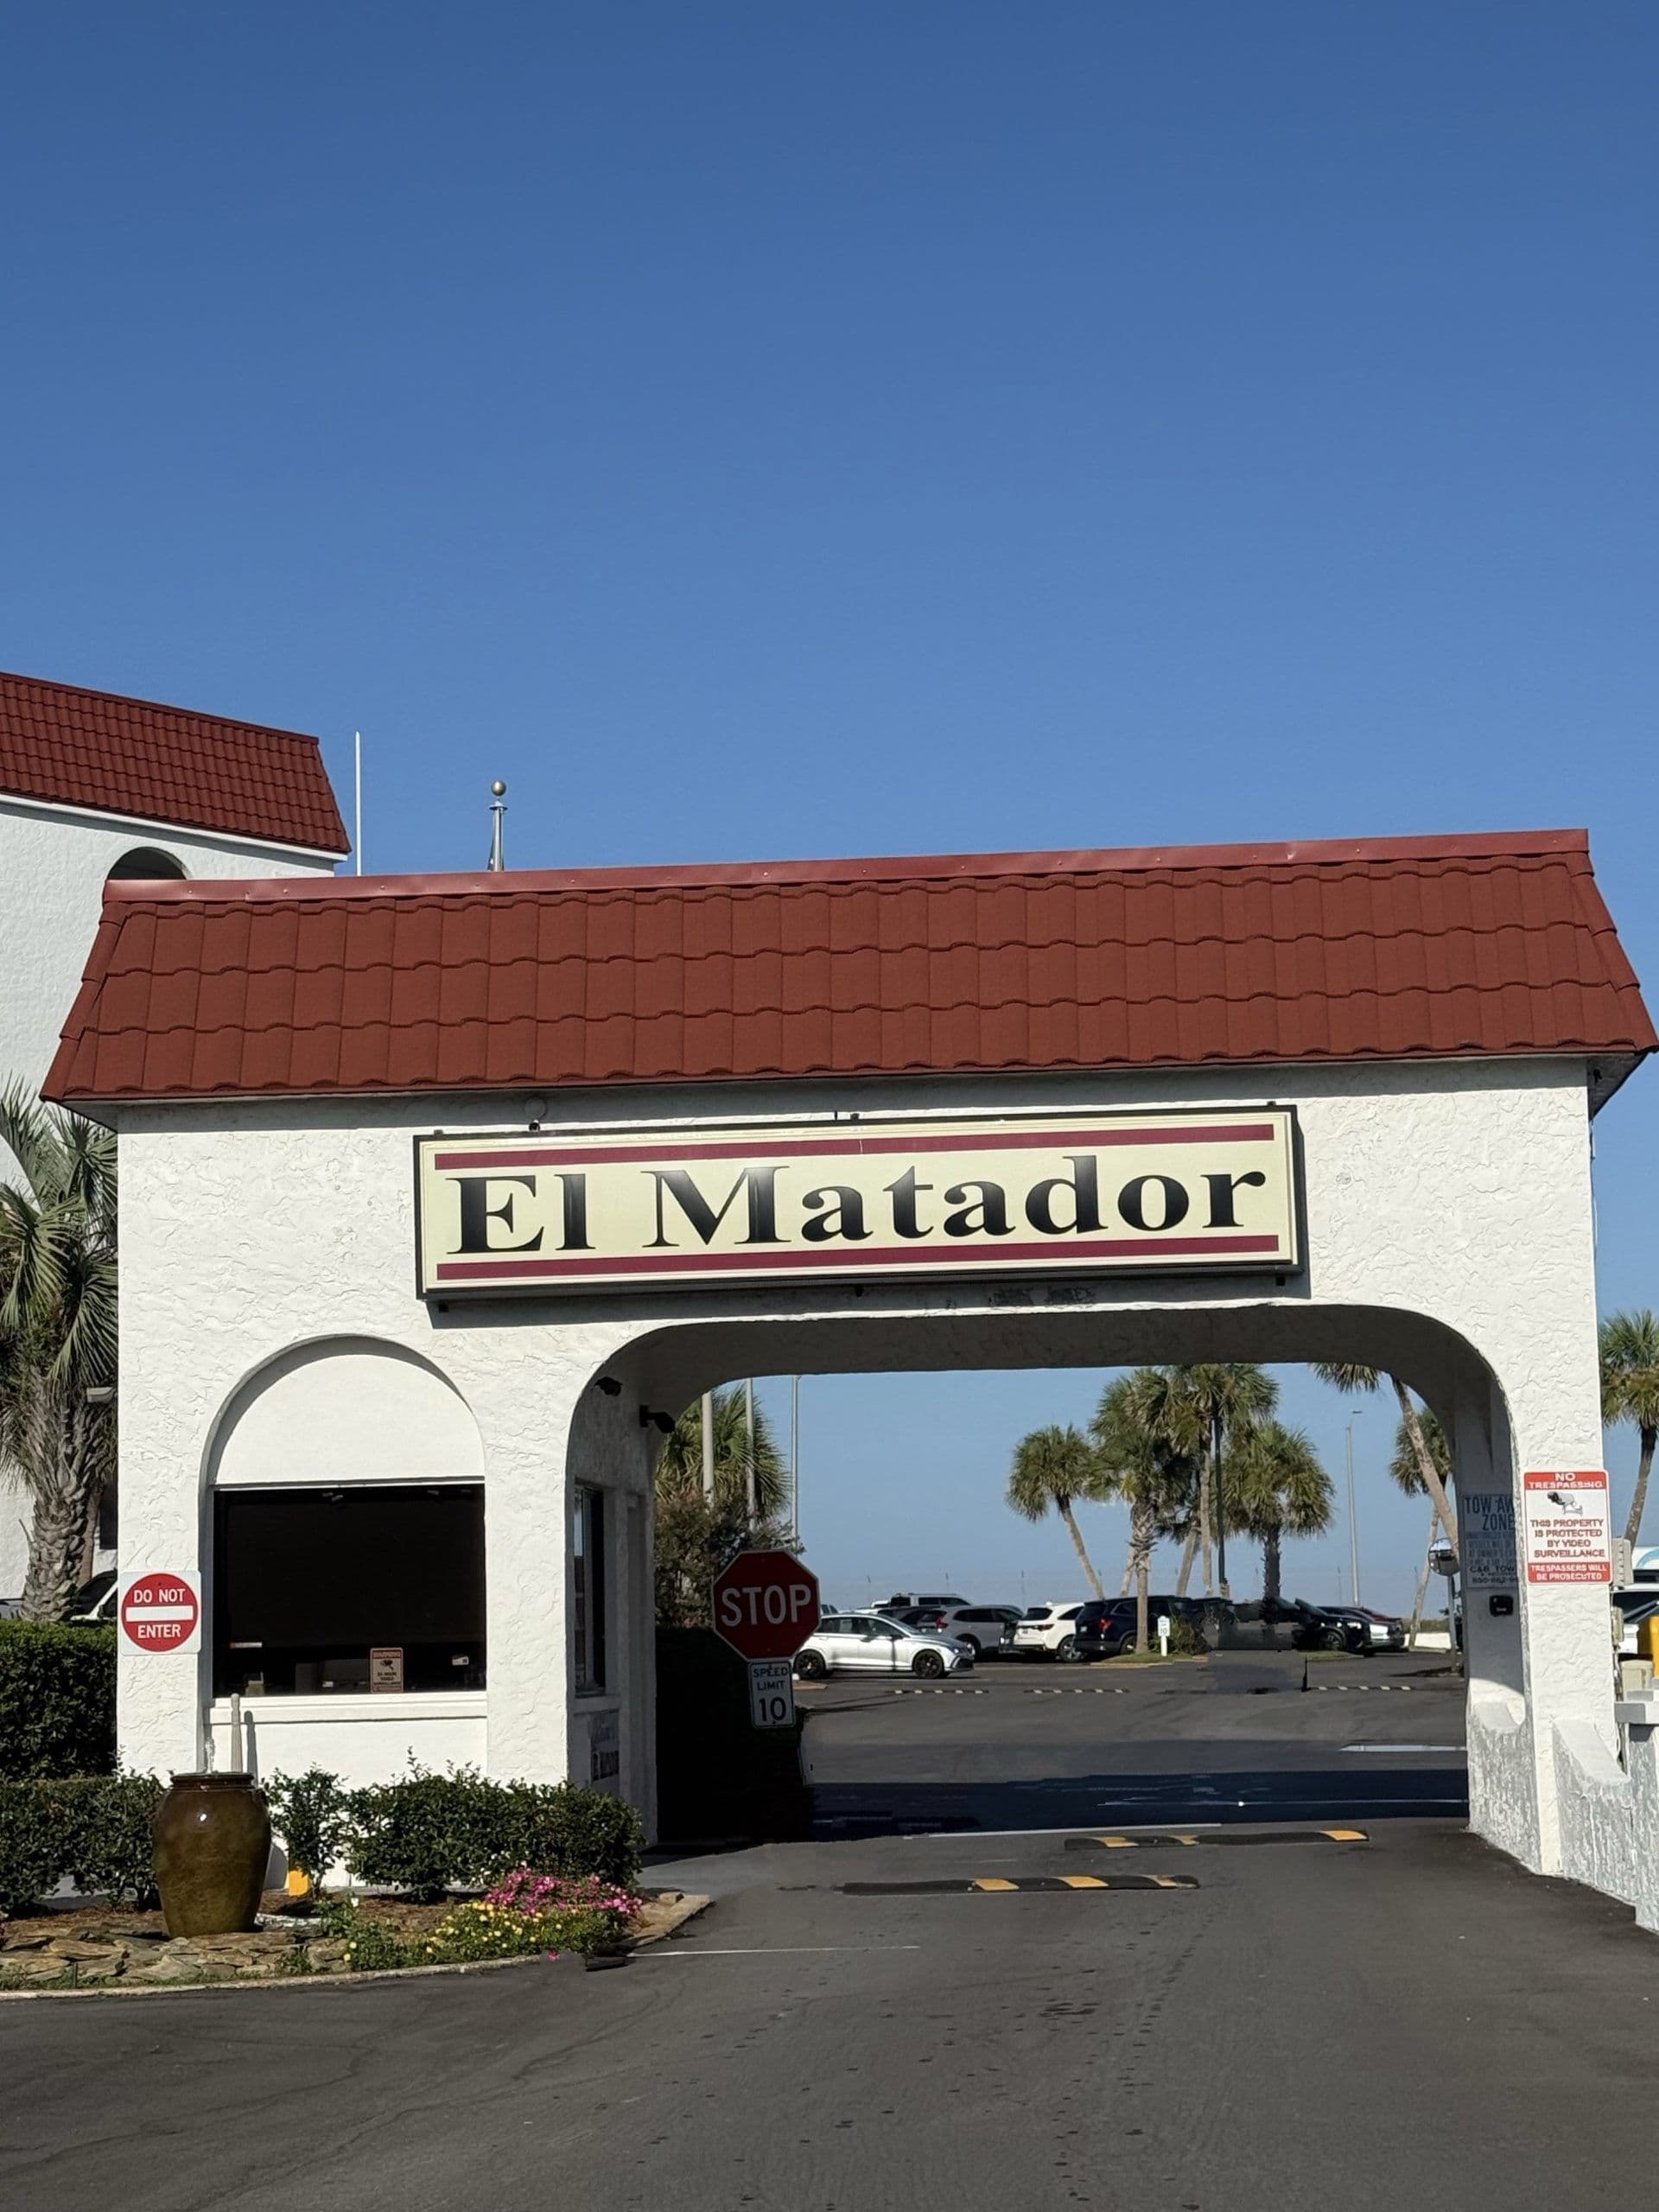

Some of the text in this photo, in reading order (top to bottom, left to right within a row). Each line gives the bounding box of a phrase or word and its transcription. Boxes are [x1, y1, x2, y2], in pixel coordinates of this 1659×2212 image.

[446, 1154, 1267, 1256] El Matador
[1555, 1472, 1576, 1481] NO
[1464, 1497, 1492, 1514] TOW
[1530, 1519, 1551, 1528] THIS
[1535, 1529, 1603, 1538] IS PROTECTED
[1561, 1539, 1591, 1548] VIDEO
[1535, 1549, 1605, 1558] SURVEILLANCE
[1530, 1564, 1586, 1573] TRESPASSERS
[1536, 1573, 1548, 1581] BE
[134, 1588, 186, 1604] DO NOT
[721, 1585, 811, 1627] STOP
[137, 1624, 181, 1639] ENTER
[753, 1666, 788, 1679] SPEED
[757, 1680, 785, 1691] LIMIT
[758, 1696, 786, 1722] 10
